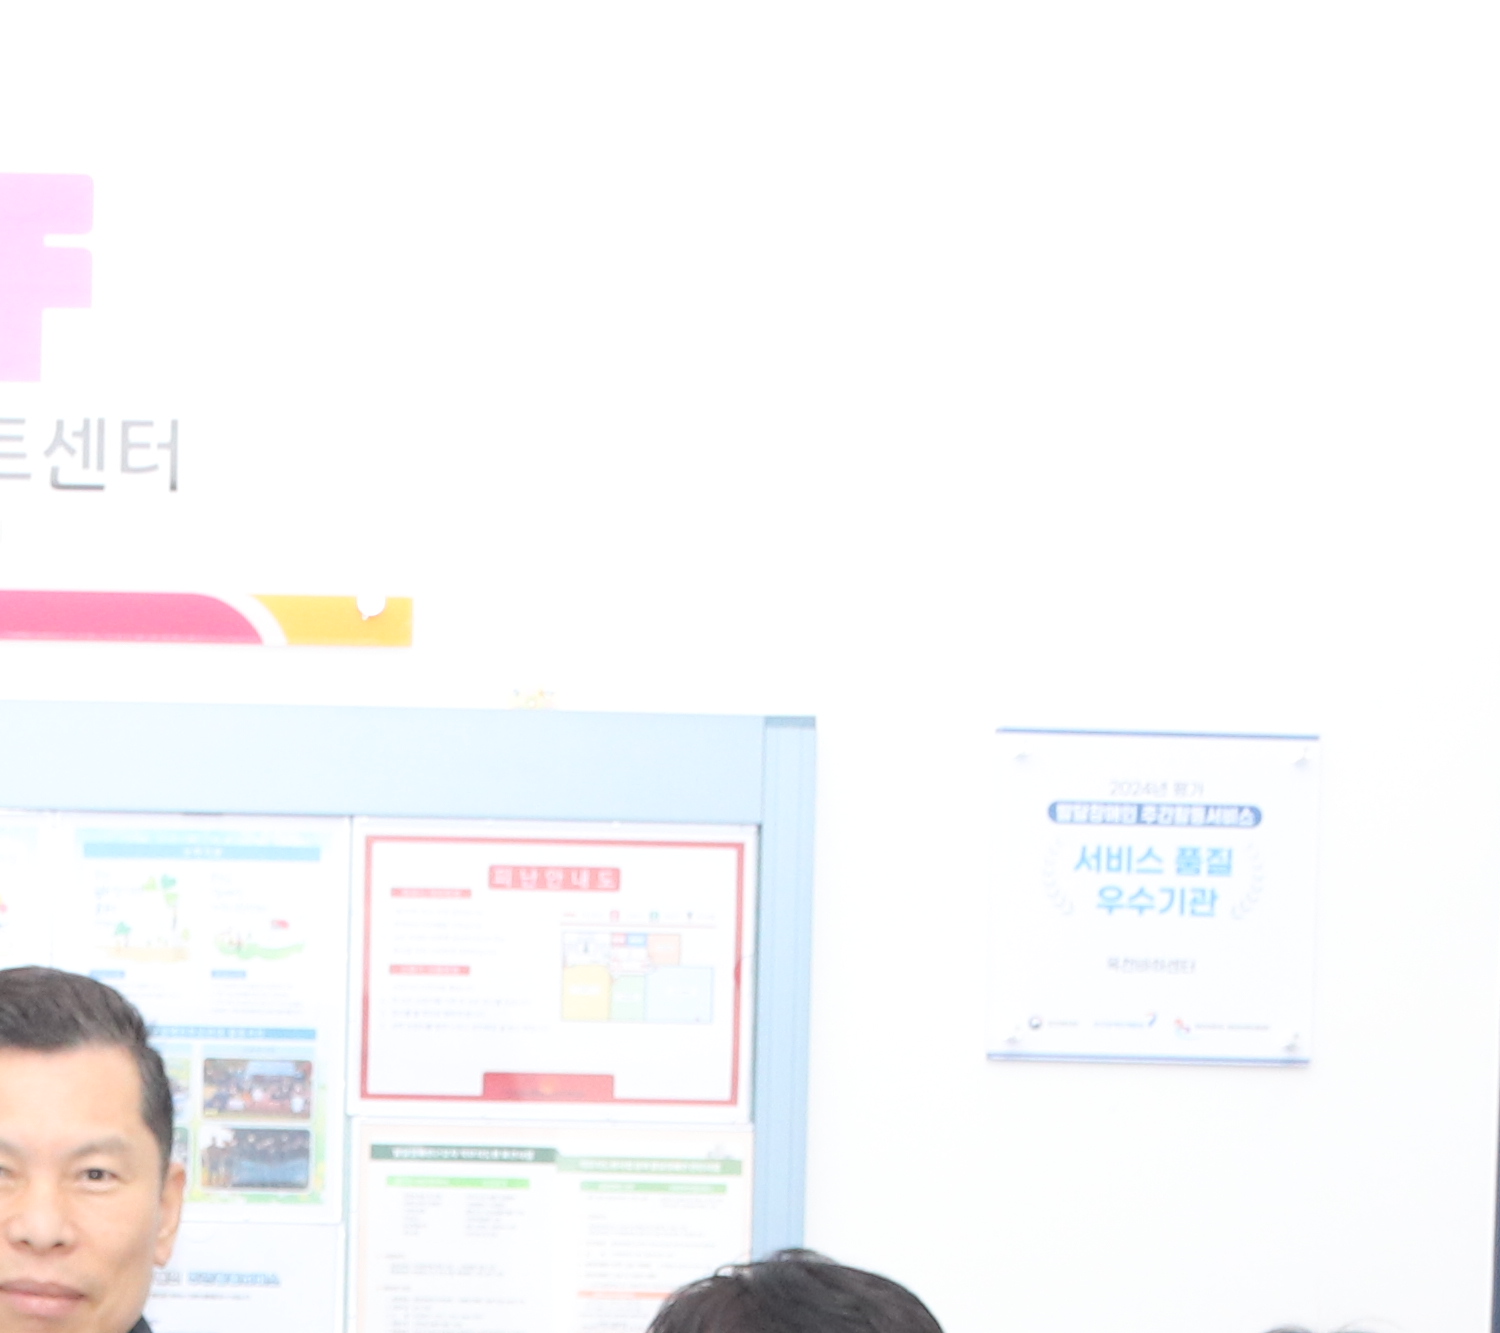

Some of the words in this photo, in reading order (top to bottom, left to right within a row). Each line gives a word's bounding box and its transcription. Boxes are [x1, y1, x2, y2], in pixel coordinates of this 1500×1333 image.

[1110, 781, 1168, 798] 2024년
[1073, 845, 1164, 875] 서비스
[1175, 846, 1235, 878] 품질
[1096, 884, 1219, 918] 우수기관
